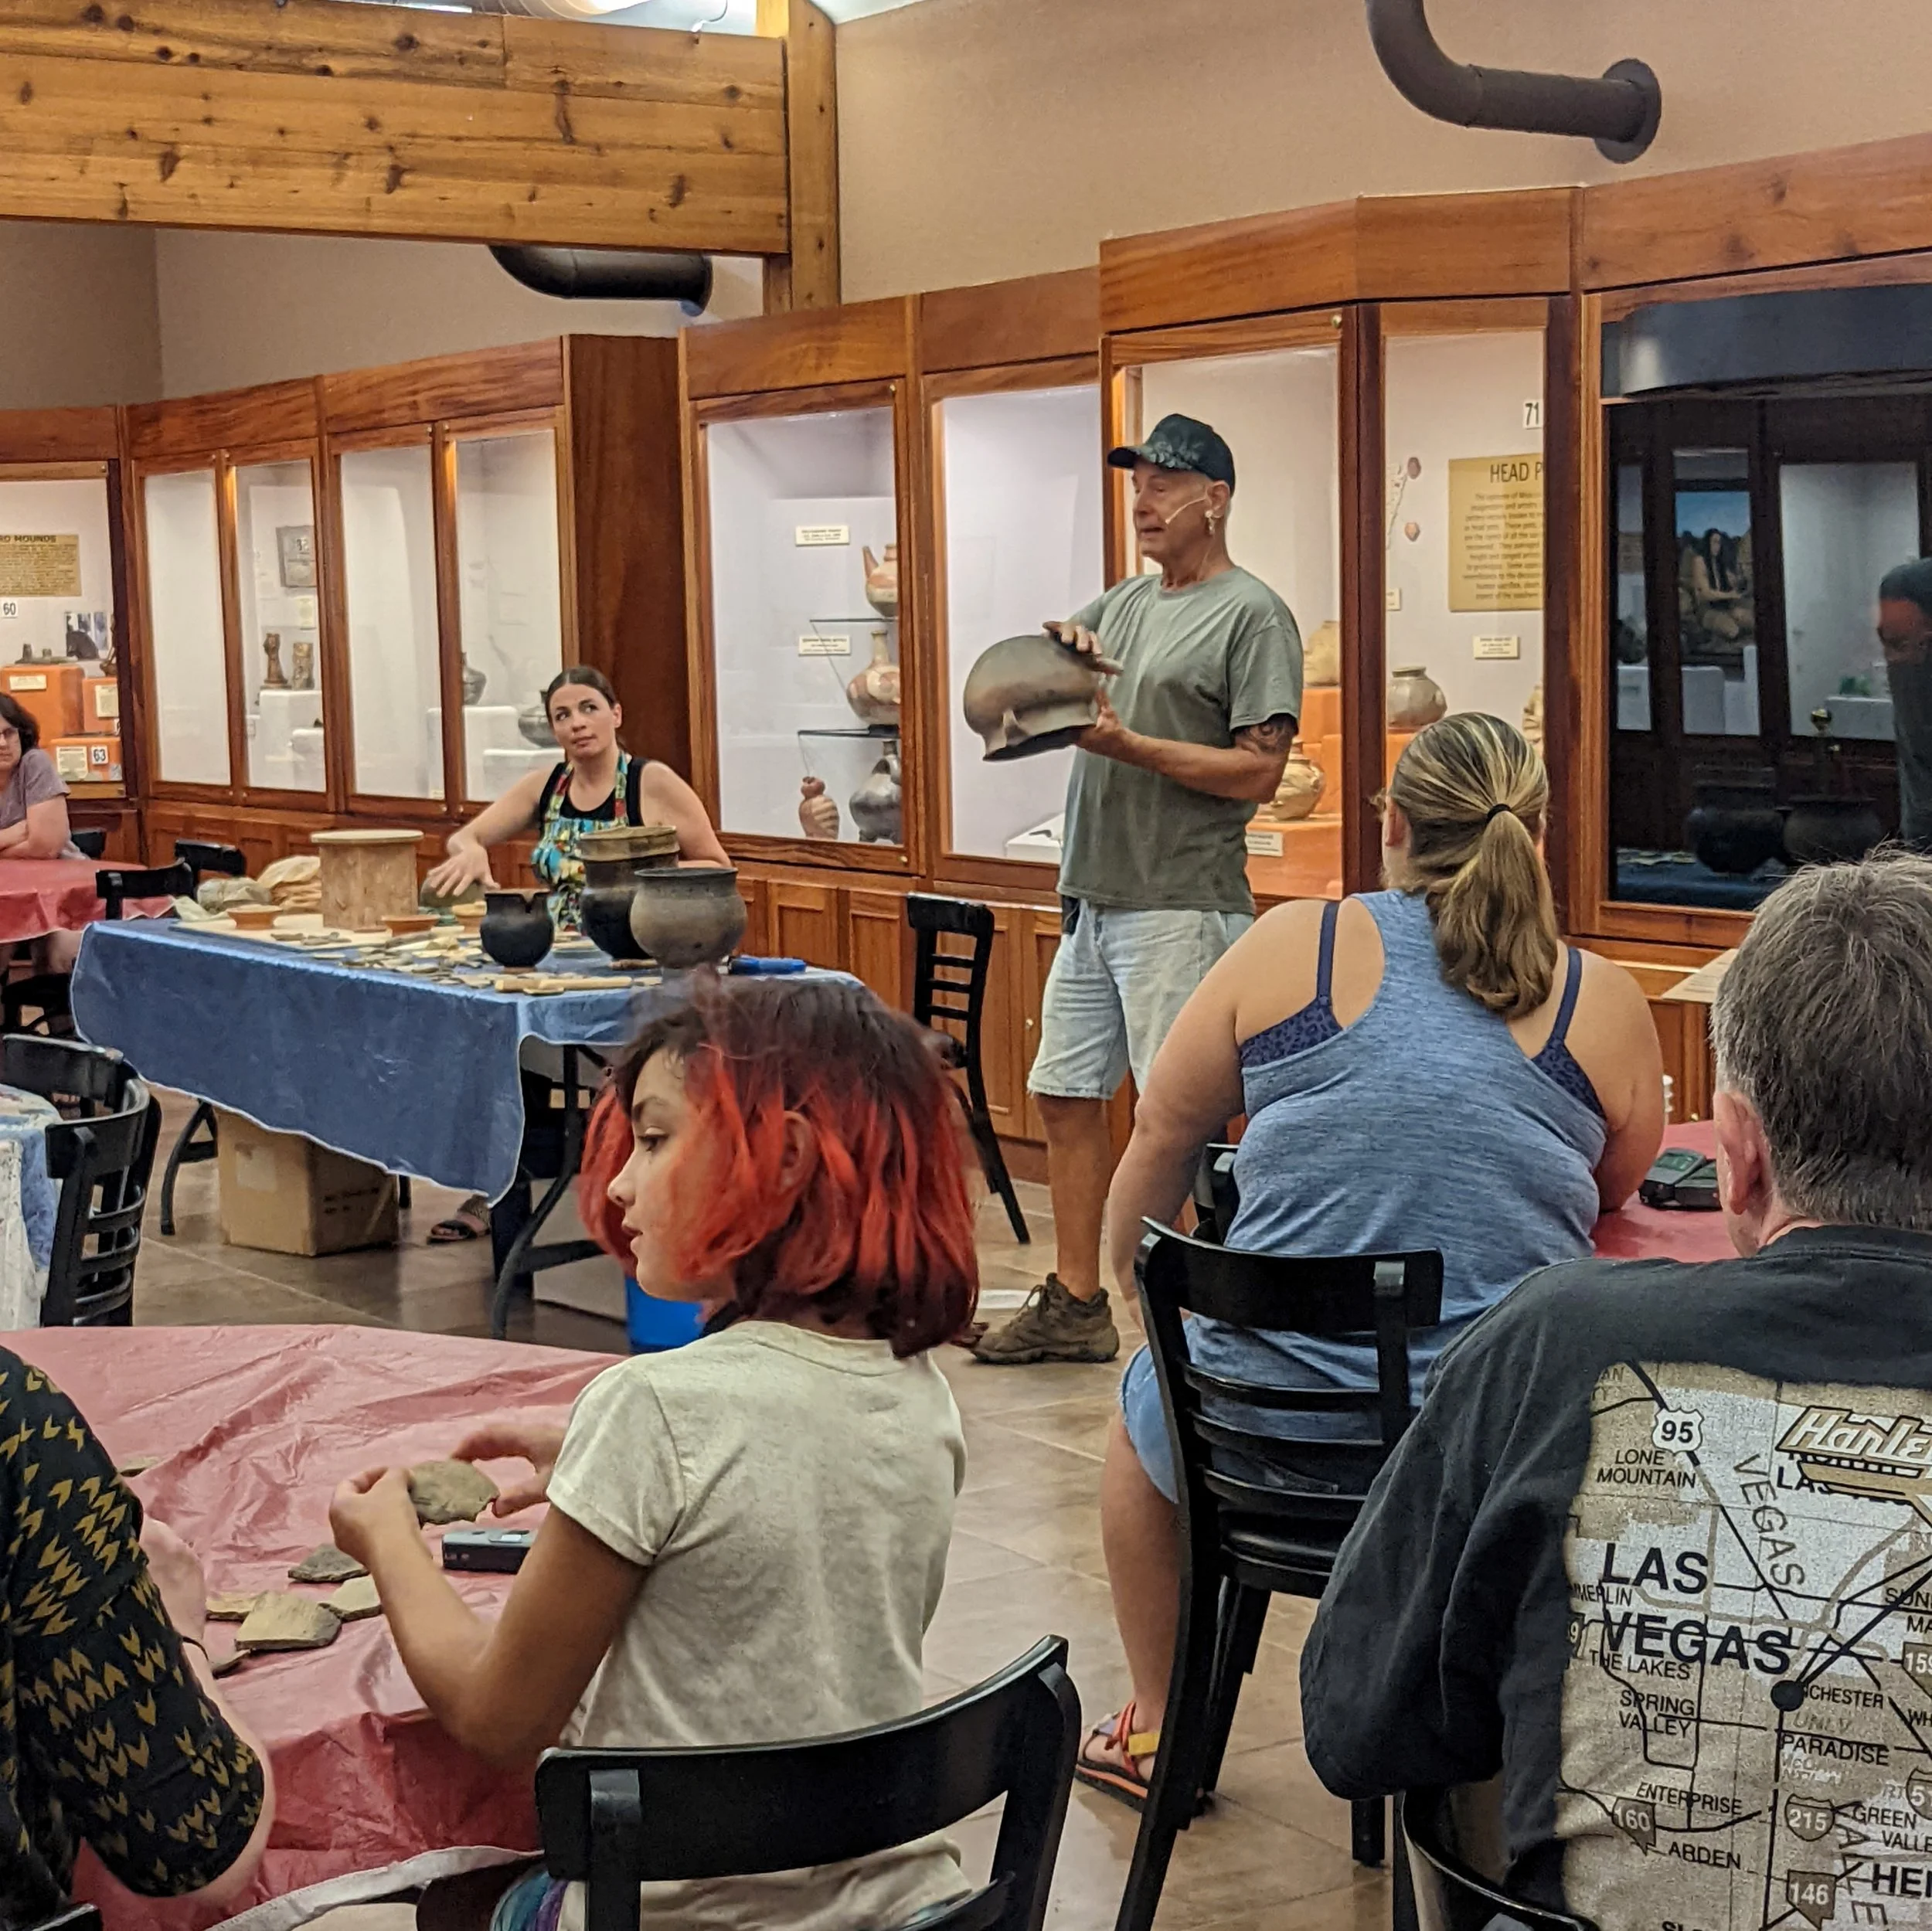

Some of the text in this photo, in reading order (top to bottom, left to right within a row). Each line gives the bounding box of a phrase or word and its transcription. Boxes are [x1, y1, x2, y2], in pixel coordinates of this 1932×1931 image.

[1525, 401, 1539, 426] 71
[1490, 462, 1529, 483] HEAD
[3, 602, 16, 616] 60
[94, 748, 107, 762] 63
[1661, 1420, 1693, 1443] 95
[1787, 1412, 1932, 1465] Harle
[1614, 1449, 1665, 1466] LONE
[1597, 1467, 1696, 1489] MOUNTAIN
[1733, 1453, 1805, 1586] VEGAS
[1600, 1542, 1709, 1594] LAS
[1885, 1587, 1932, 1609] SUN
[1603, 1610, 1790, 1675] VEGAS
[1589, 1649, 1691, 1680] THE LAKES
[1620, 1690, 1695, 1716] SPRING
[1619, 1711, 1691, 1739] VALLEY
[1781, 1734, 1889, 1766] PARADISE
[1636, 1782, 1743, 1814] ENTERPRISE
[1910, 1785, 1932, 1807] 5
[1613, 1807, 1651, 1831] 160
[1789, 1809, 1828, 1831] 215
[1852, 1804, 1917, 1830] GREEN
[1872, 1863, 1932, 1898] HE
[1789, 1882, 1829, 1905] 146
